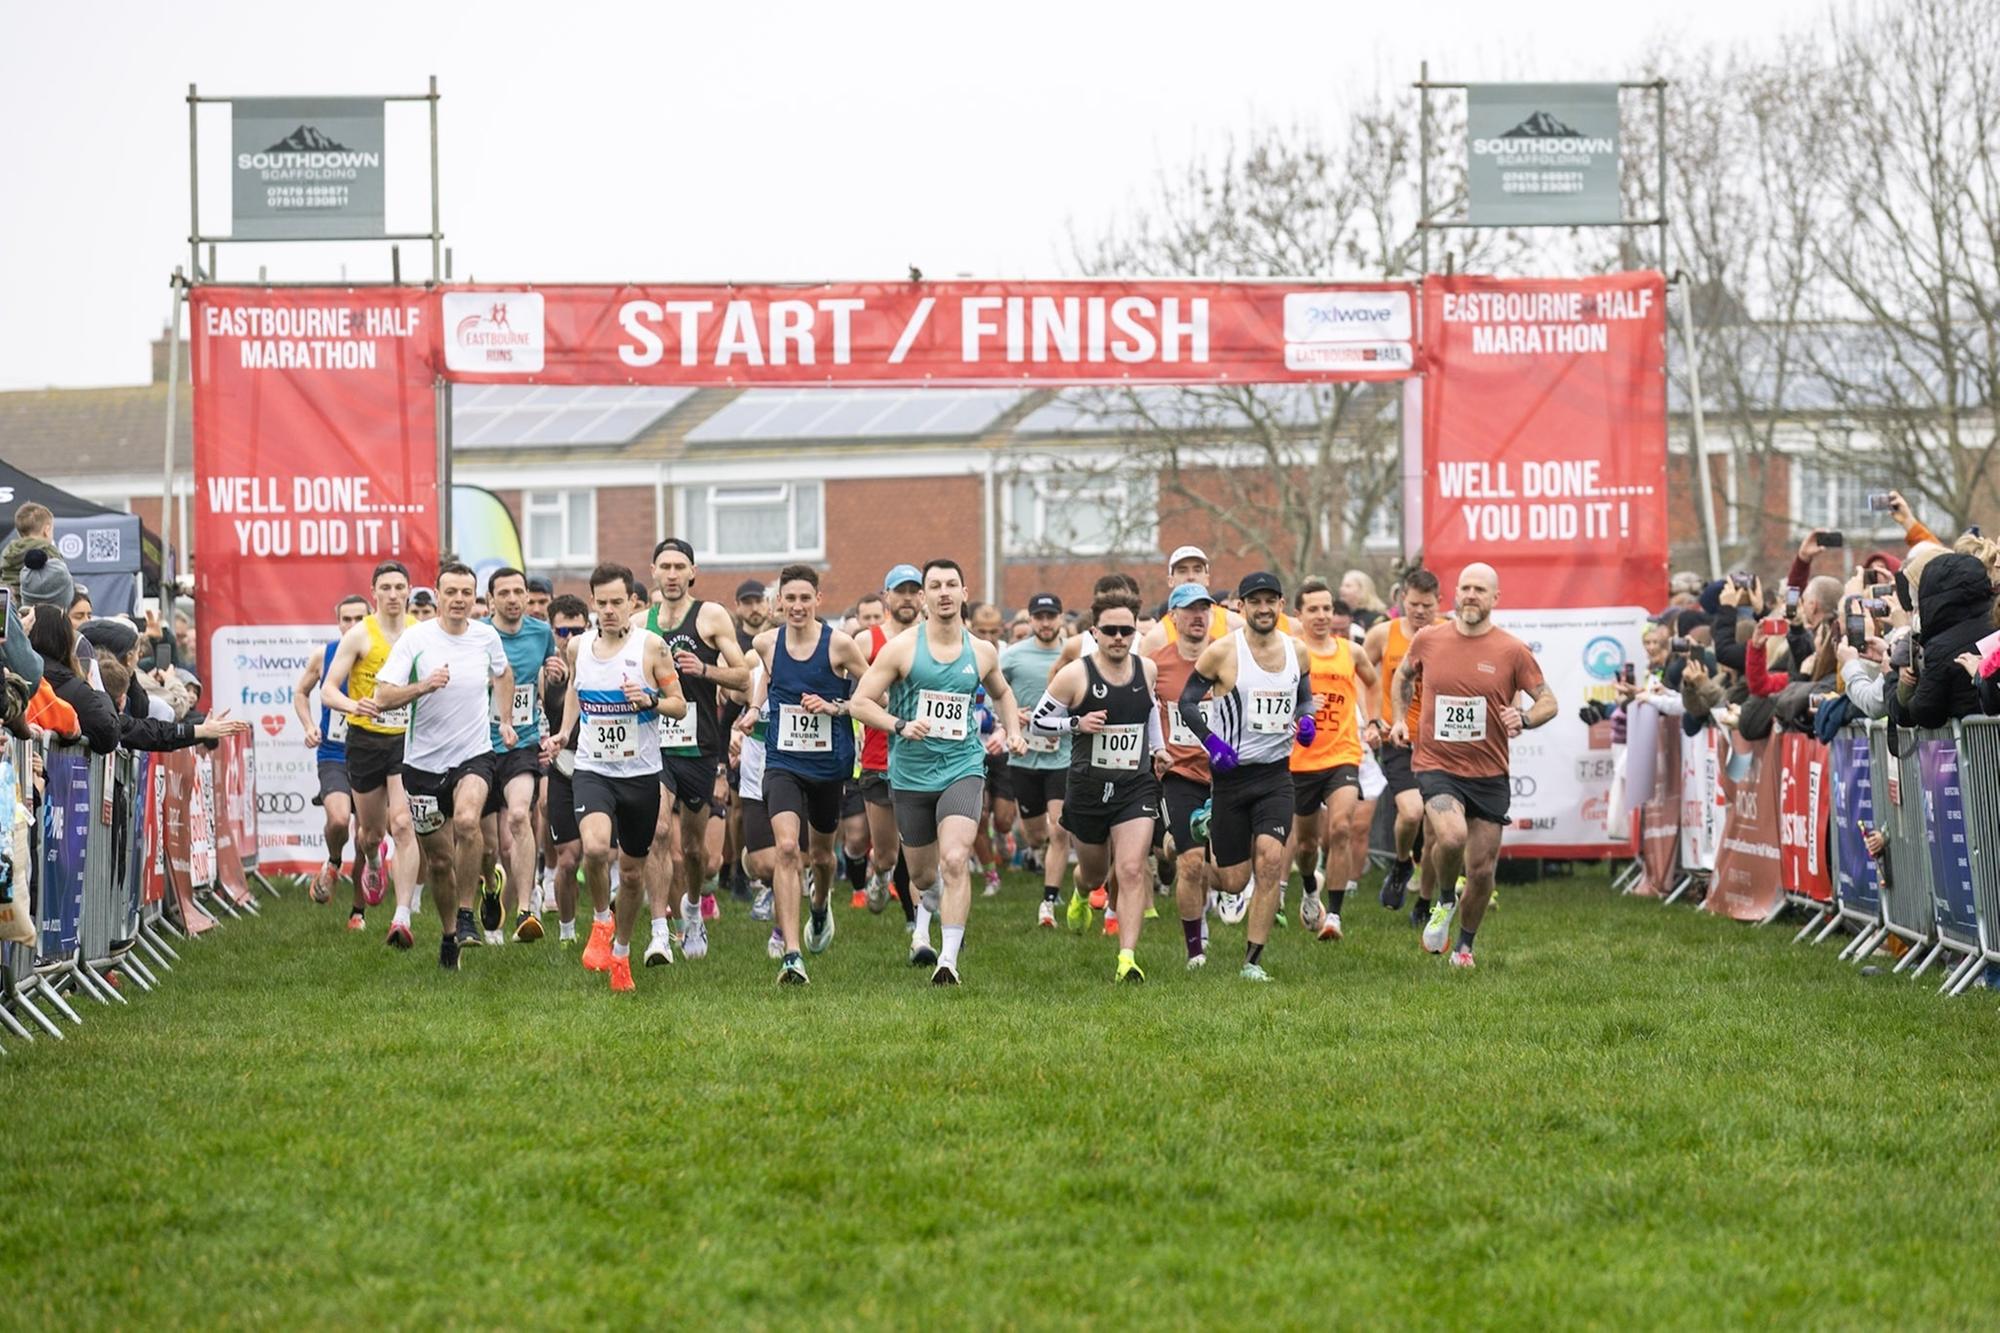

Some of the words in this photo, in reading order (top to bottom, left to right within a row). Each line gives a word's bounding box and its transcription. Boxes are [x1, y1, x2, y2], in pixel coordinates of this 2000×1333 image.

[1473, 138, 1613, 154] SOUTHDOWN
[238, 152, 379, 169] SOUTHDOWN
[1496, 155, 1591, 165] SCAFFOLDING
[261, 169, 357, 180] SCAFFOLDING
[1443, 293, 1581, 322] EASTBOURNE
[1597, 290, 1653, 319] HALF
[207, 307, 350, 337] EASTBOURNE
[366, 308, 419, 336] HALF
[466, 332, 529, 346] EASTBOURNE
[618, 299, 864, 367] START
[887, 297, 936, 364] /
[961, 297, 1210, 363] FINISH
[1473, 325, 1607, 353] MARATHON
[241, 340, 376, 369] MARATHON
[486, 349, 513, 361] RUNS
[1439, 462, 1514, 498] WELL
[208, 477, 285, 513] WELL
[1463, 505, 1520, 541] YOU
[1529, 504, 1577, 540] DID
[1584, 503, 1613, 538] IT
[234, 519, 290, 556] YOU
[299, 519, 348, 556] DID
[355, 519, 383, 556] IT
[926, 700, 962, 720] 1038
[1256, 698, 1291, 714] 1178
[1446, 706, 1474, 722] 284
[791, 715, 819, 732] 194
[598, 726, 626, 743] 340
[1101, 734, 1138, 751] 1007
[1535, 817, 1557, 830] HALF
[300, 834, 326, 847] HALF
